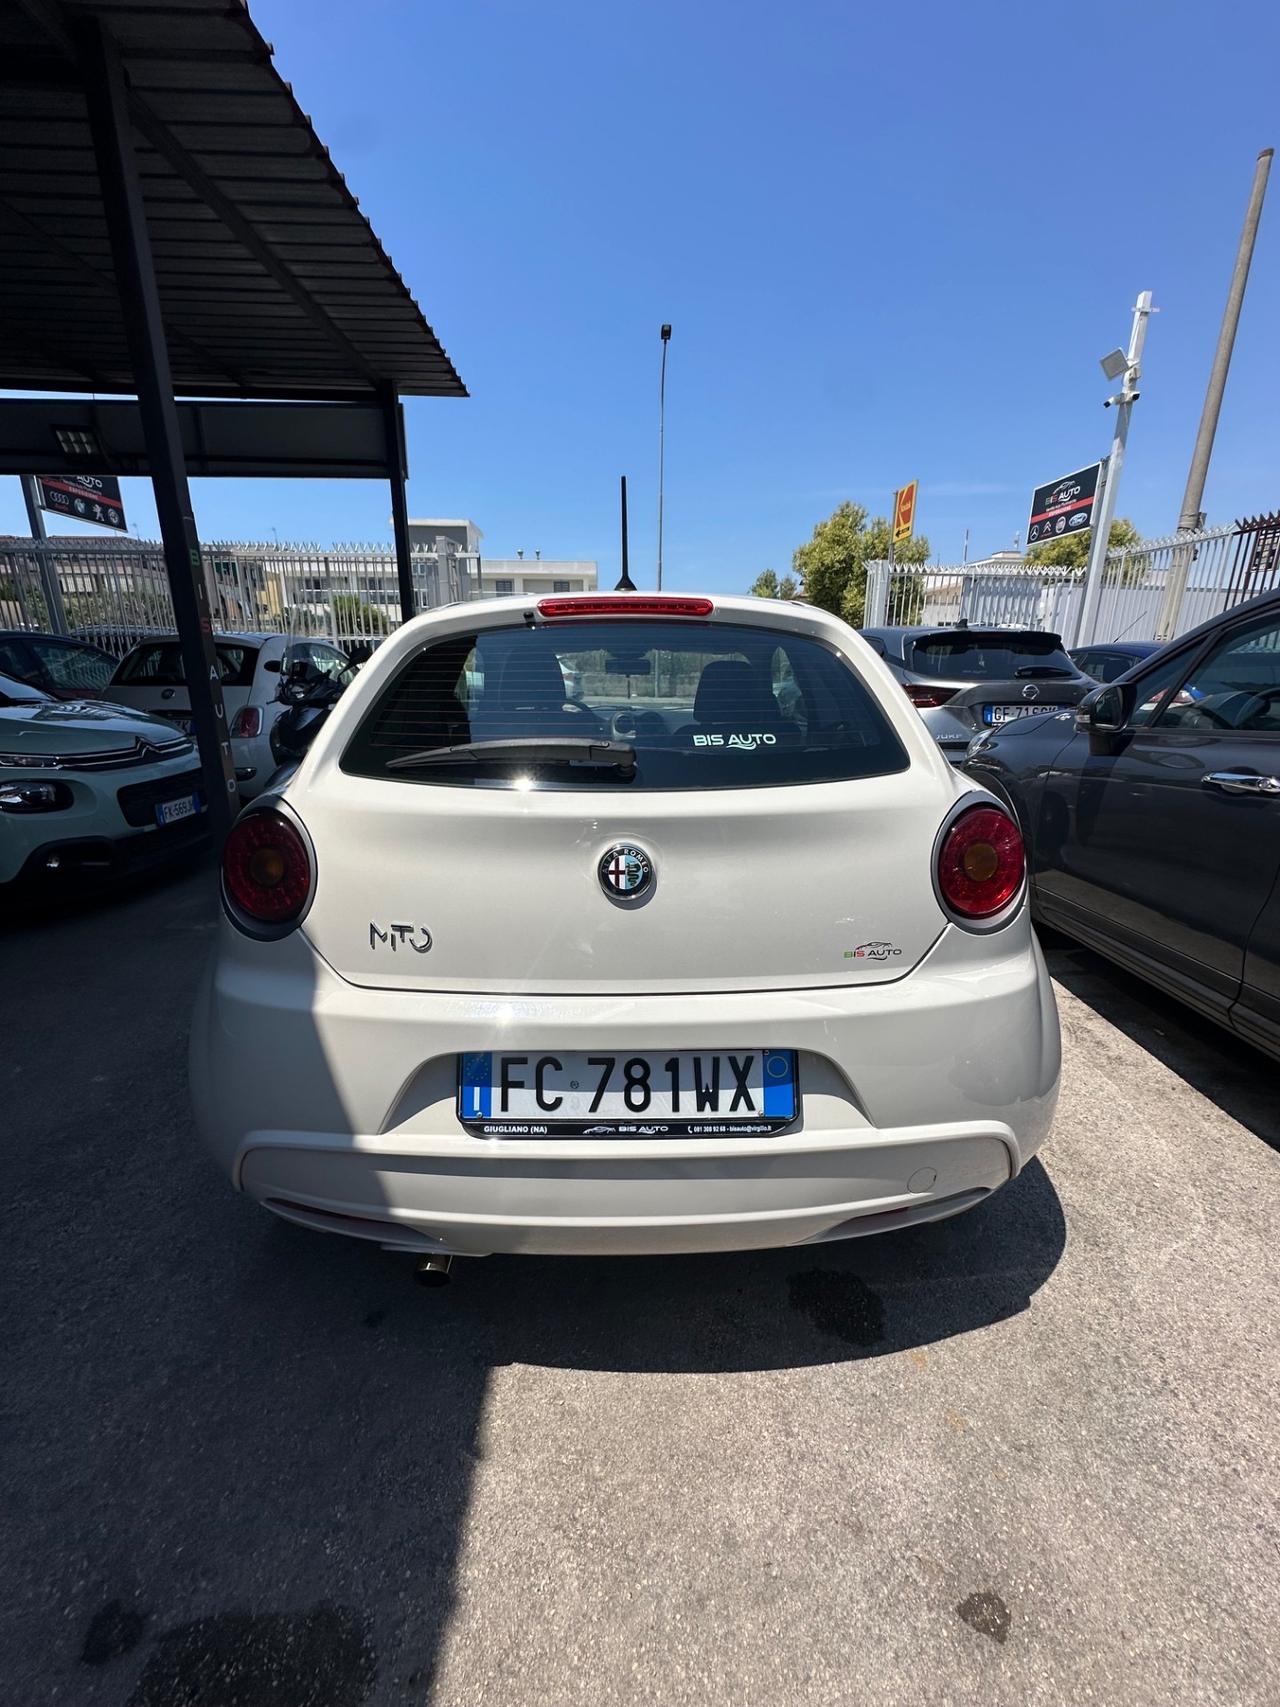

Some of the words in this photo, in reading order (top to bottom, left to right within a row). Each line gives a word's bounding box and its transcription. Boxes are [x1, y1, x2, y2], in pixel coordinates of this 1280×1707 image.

[1058, 486, 1081, 500] AUTO
[994, 707, 1010, 721] GF
[693, 735, 724, 746] BIS
[728, 734, 776, 745] AUTO
[624, 849, 649, 873] ROMEO
[844, 950, 865, 958] BIS
[868, 949, 902, 957] AUTO
[501, 1056, 563, 1113] FC
[587, 1056, 756, 1113] 781WX
[483, 1125, 529, 1133] GIUGLIANO
[530, 1125, 548, 1135] (NA)
[638, 1125, 669, 1133] AUTO
